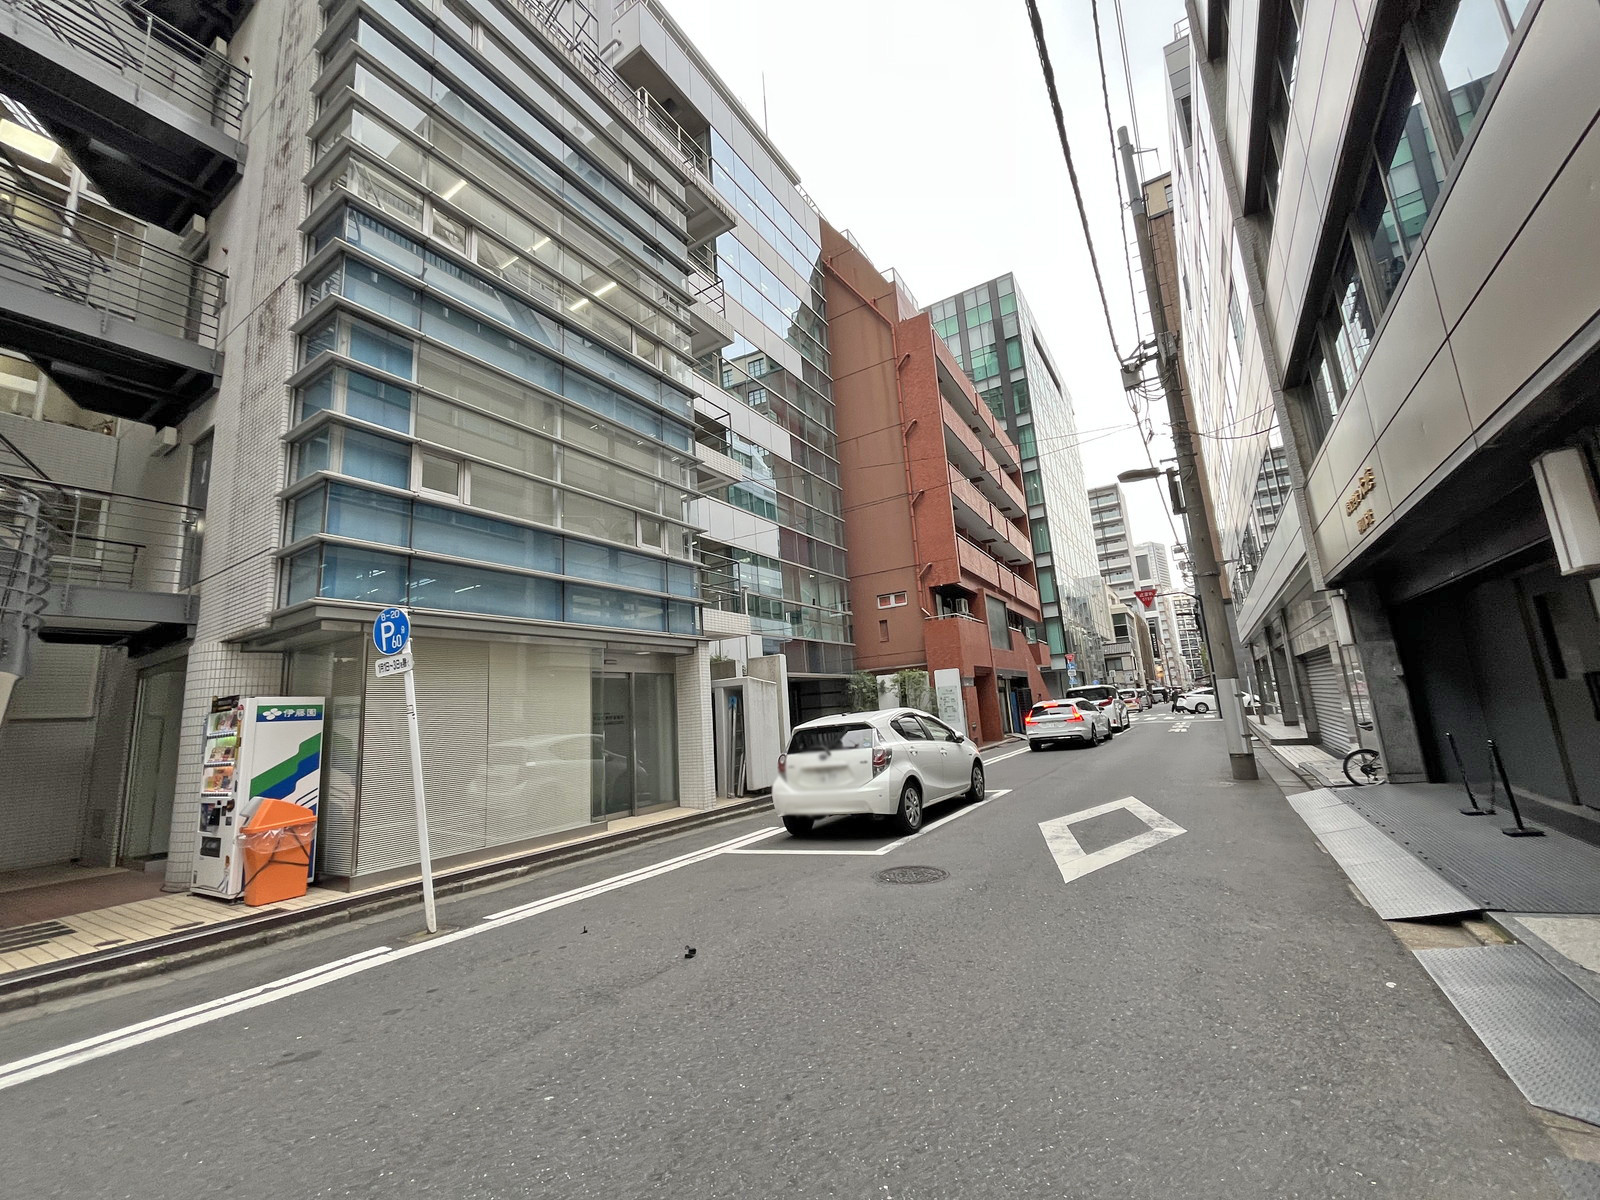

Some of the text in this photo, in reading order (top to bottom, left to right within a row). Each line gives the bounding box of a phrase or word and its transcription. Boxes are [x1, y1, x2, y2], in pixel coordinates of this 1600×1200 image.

[380, 610, 400, 621] 8-20
[381, 621, 395, 651] P
[283, 708, 316, 718] 伊藤園
